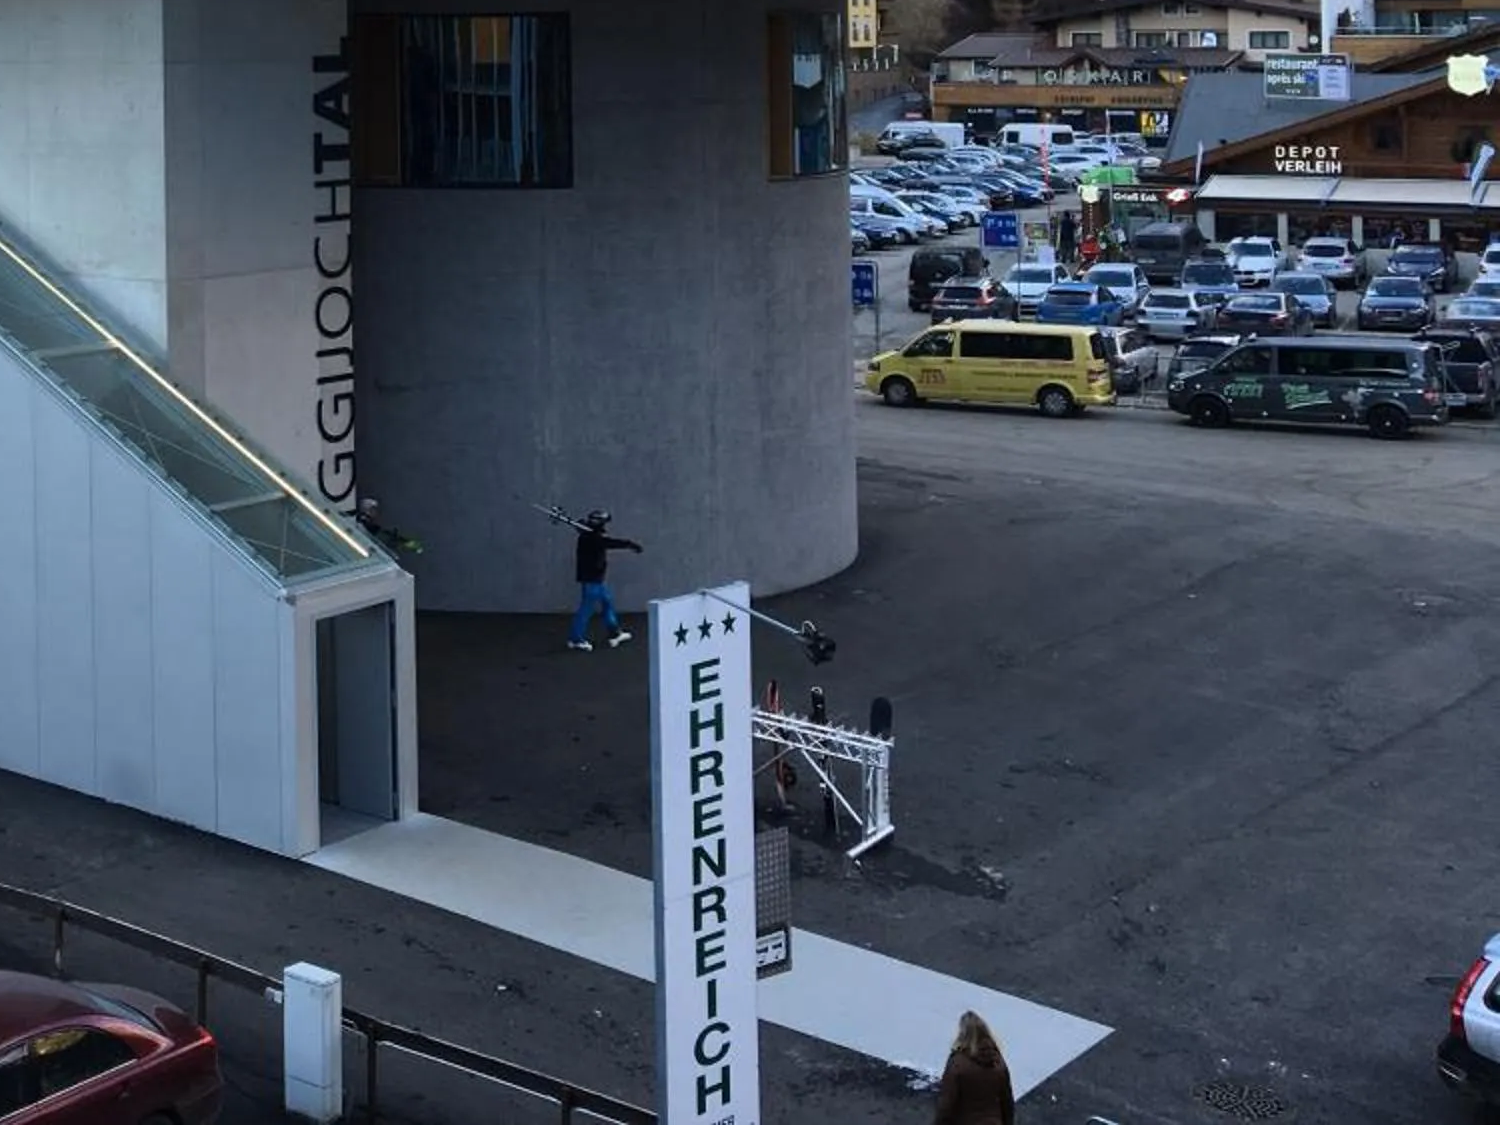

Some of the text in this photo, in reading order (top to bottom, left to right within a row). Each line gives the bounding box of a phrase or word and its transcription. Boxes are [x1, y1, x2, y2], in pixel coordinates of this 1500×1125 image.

[1275, 146, 1341, 159] DEPOT
[1275, 160, 1342, 174] VERLEIH
[689, 657, 733, 1116] EHRENREICH
